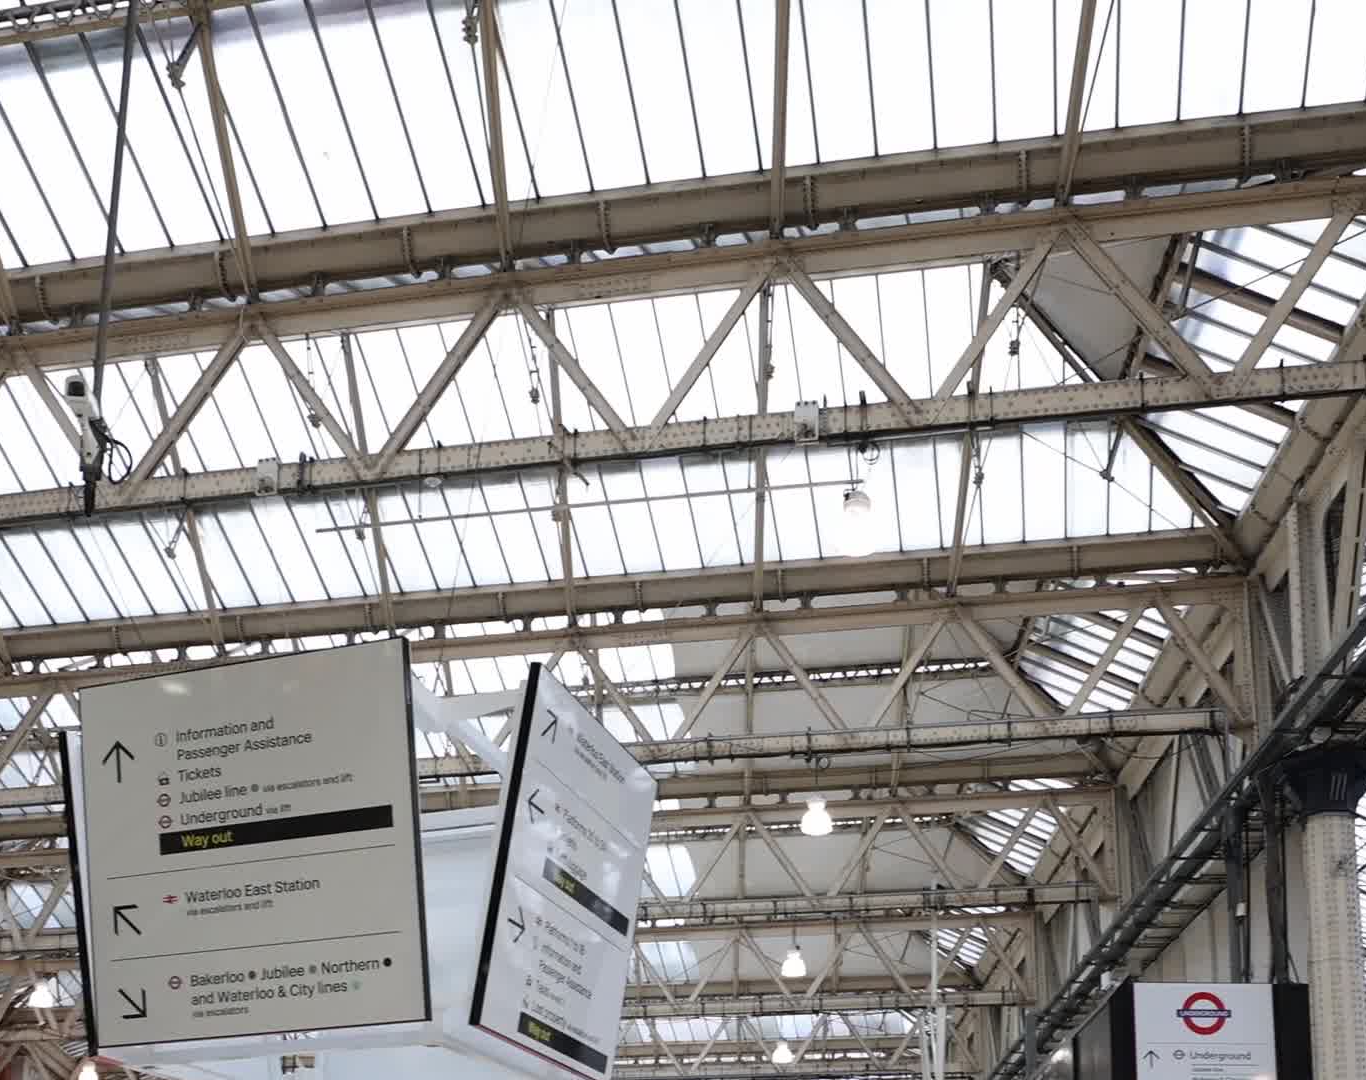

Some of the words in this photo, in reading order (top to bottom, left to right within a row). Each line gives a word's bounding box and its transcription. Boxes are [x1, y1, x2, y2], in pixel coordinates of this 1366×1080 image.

[176, 720, 248, 744] Information
[251, 717, 275, 732] and
[176, 743, 240, 761] Passenger
[243, 731, 313, 752] Assistance
[178, 765, 222, 783] Tickets
[179, 785, 223, 805] Jubilee
[224, 783, 248, 799] line
[180, 803, 263, 826] Underground
[181, 832, 210, 849] Way
[213, 830, 234, 844] out
[184, 887, 243, 904] Waterloo
[244, 883, 273, 897] East
[274, 877, 321, 894] Station
[190, 971, 245, 988] Bakerloo
[260, 964, 305, 982] Jubilee
[321, 958, 380, 976] Northern
[191, 992, 215, 1006] and
[217, 986, 275, 1004] Waterloo
[277, 985, 288, 998] &
[289, 981, 315, 999] City
[317, 977, 348, 994] lines
[1189, 1051, 1252, 1062] Underground
